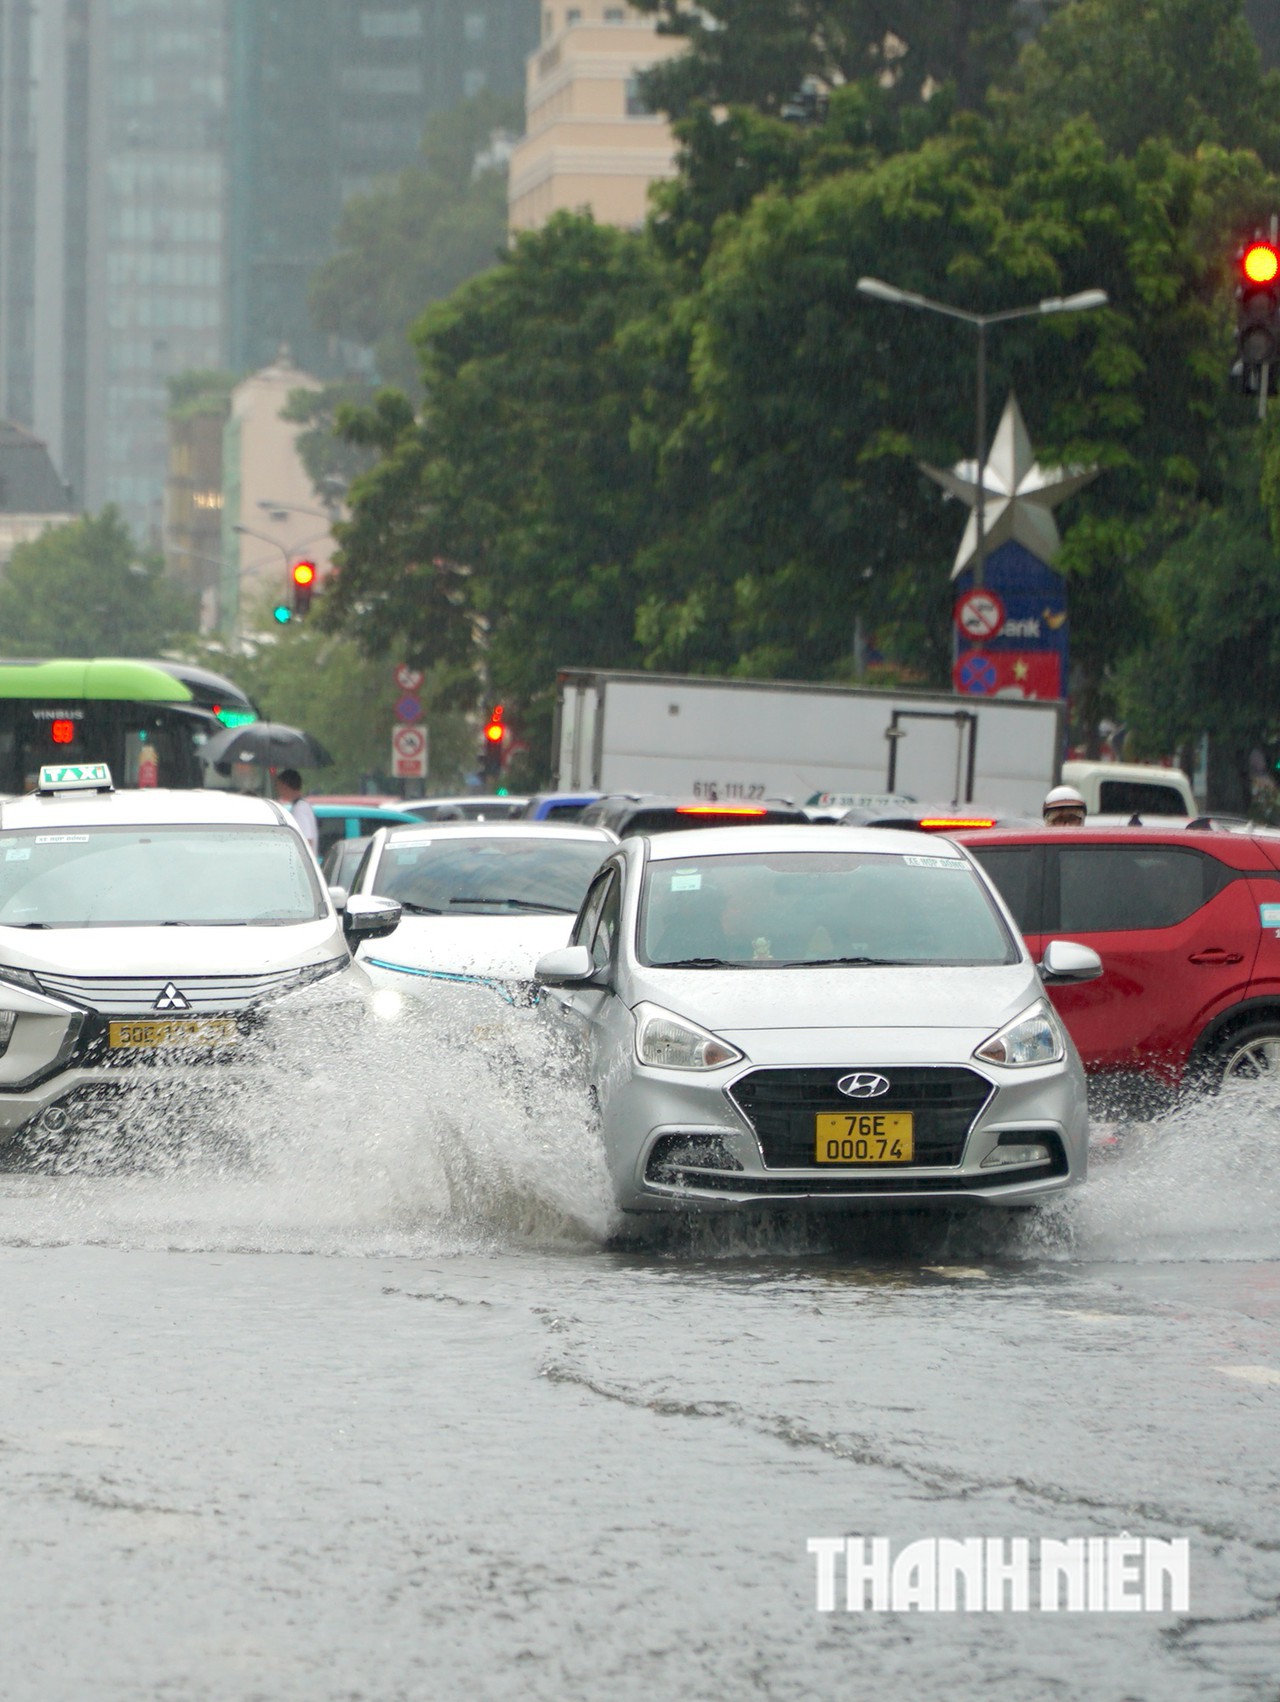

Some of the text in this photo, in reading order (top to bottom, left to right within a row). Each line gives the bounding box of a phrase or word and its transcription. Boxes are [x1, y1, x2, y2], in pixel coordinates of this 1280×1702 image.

[32, 709, 84, 720] VINBUS
[845, 1115, 885, 1136] 76E
[828, 1138, 903, 1161] 000.74
